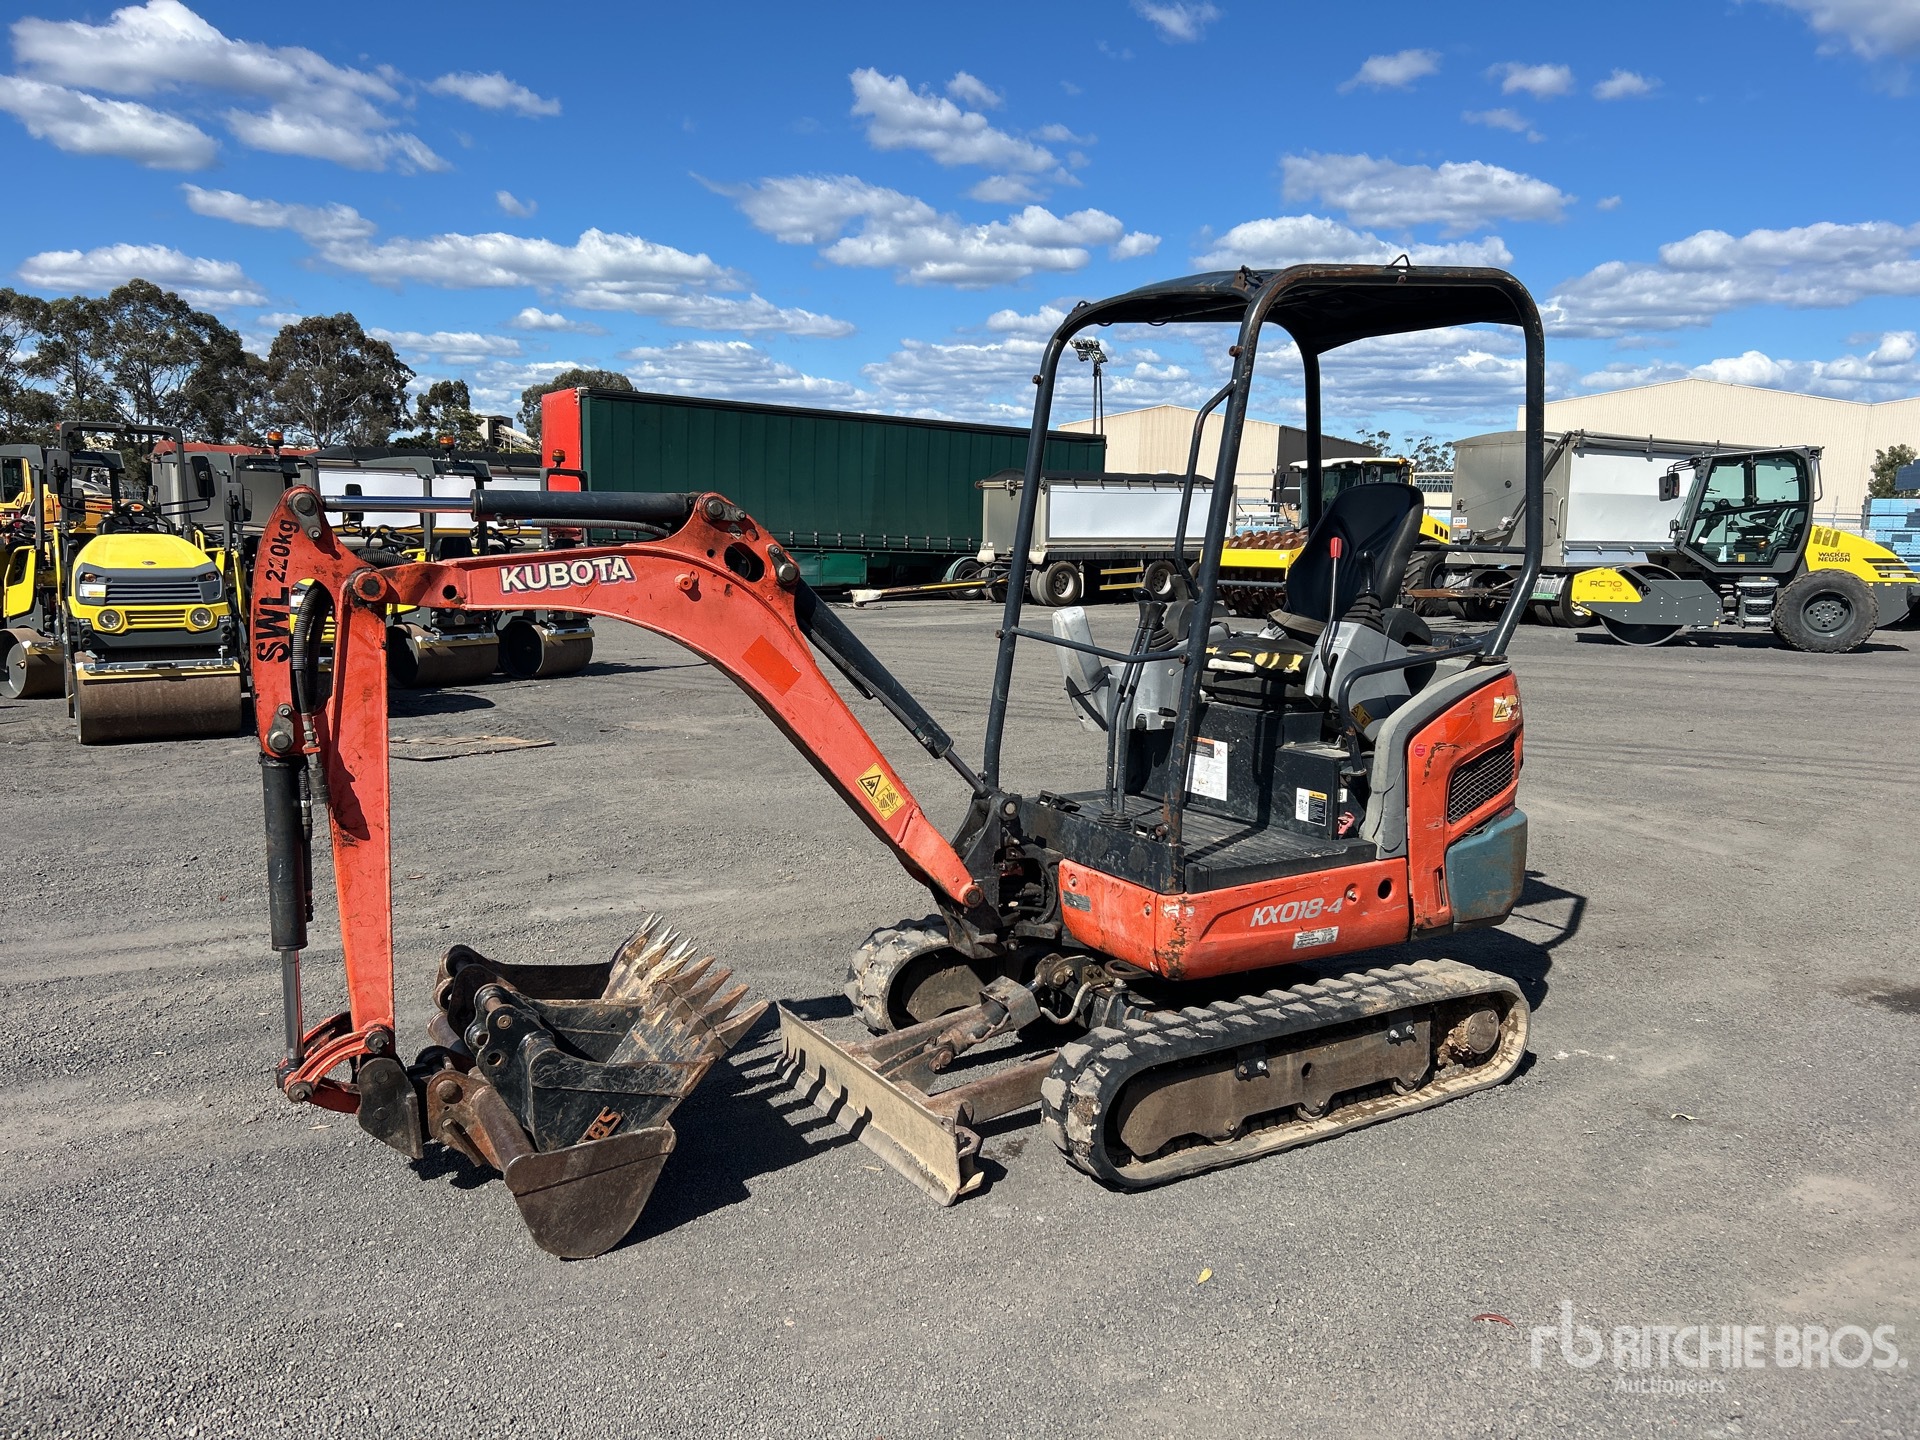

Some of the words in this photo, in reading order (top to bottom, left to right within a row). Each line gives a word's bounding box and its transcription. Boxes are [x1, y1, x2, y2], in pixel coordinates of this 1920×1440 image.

[265, 519, 300, 583] 220kg
[500, 557, 633, 592] KUBOTA
[256, 587, 290, 662] SWL
[1250, 897, 1344, 927] KX018-4
